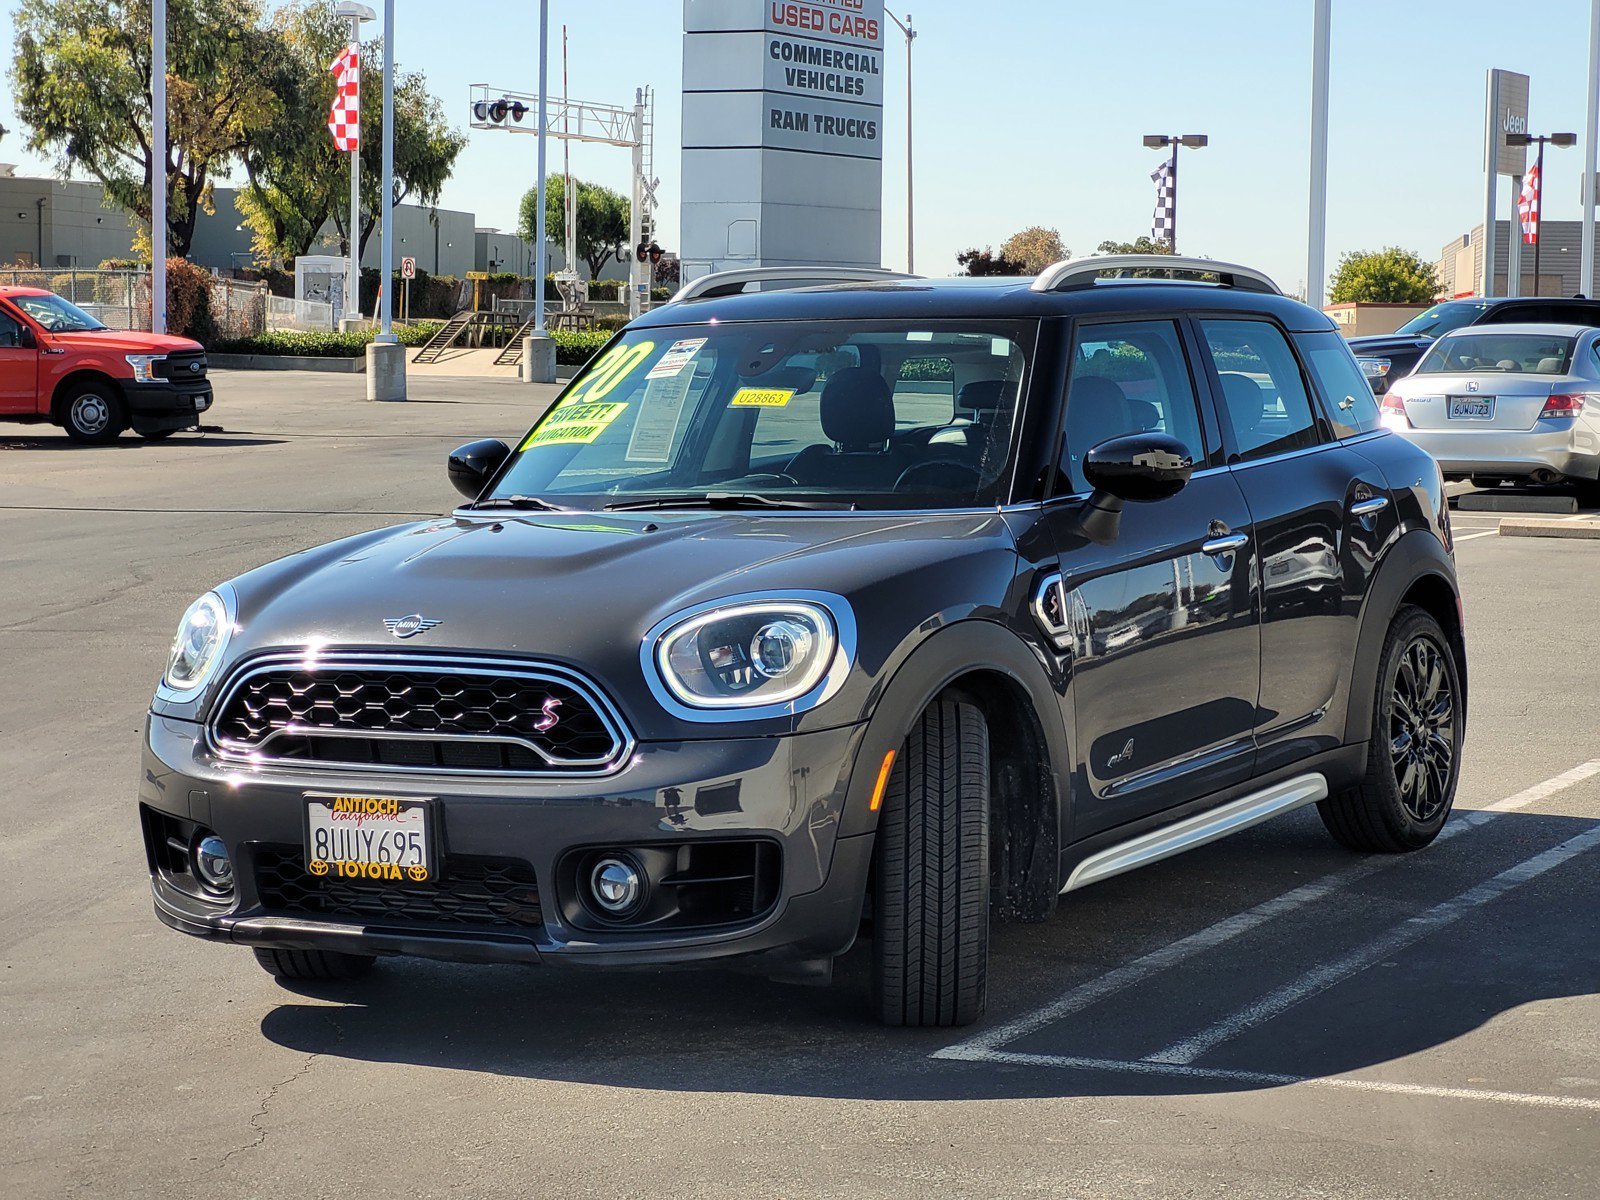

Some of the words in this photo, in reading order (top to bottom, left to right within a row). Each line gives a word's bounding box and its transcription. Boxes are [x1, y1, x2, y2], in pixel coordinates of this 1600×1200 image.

[772, 2, 824, 31] USED
[829, 13, 878, 40] CARS
[769, 40, 879, 75] COMMERCIAL
[785, 67, 864, 96] VEHICLES
[770, 109, 809, 132] RAM
[814, 115, 876, 140] TRUCKS
[1503, 107, 1525, 134] Jeep
[554, 341, 655, 408] 20
[738, 393, 785, 404] U28863
[1454, 404, 1489, 416] 6JWJ723
[545, 403, 617, 427] SWEET!
[333, 797, 399, 815] ANTIOCH
[315, 827, 422, 866] 8UUY695
[336, 860, 403, 880] TOYOTA
